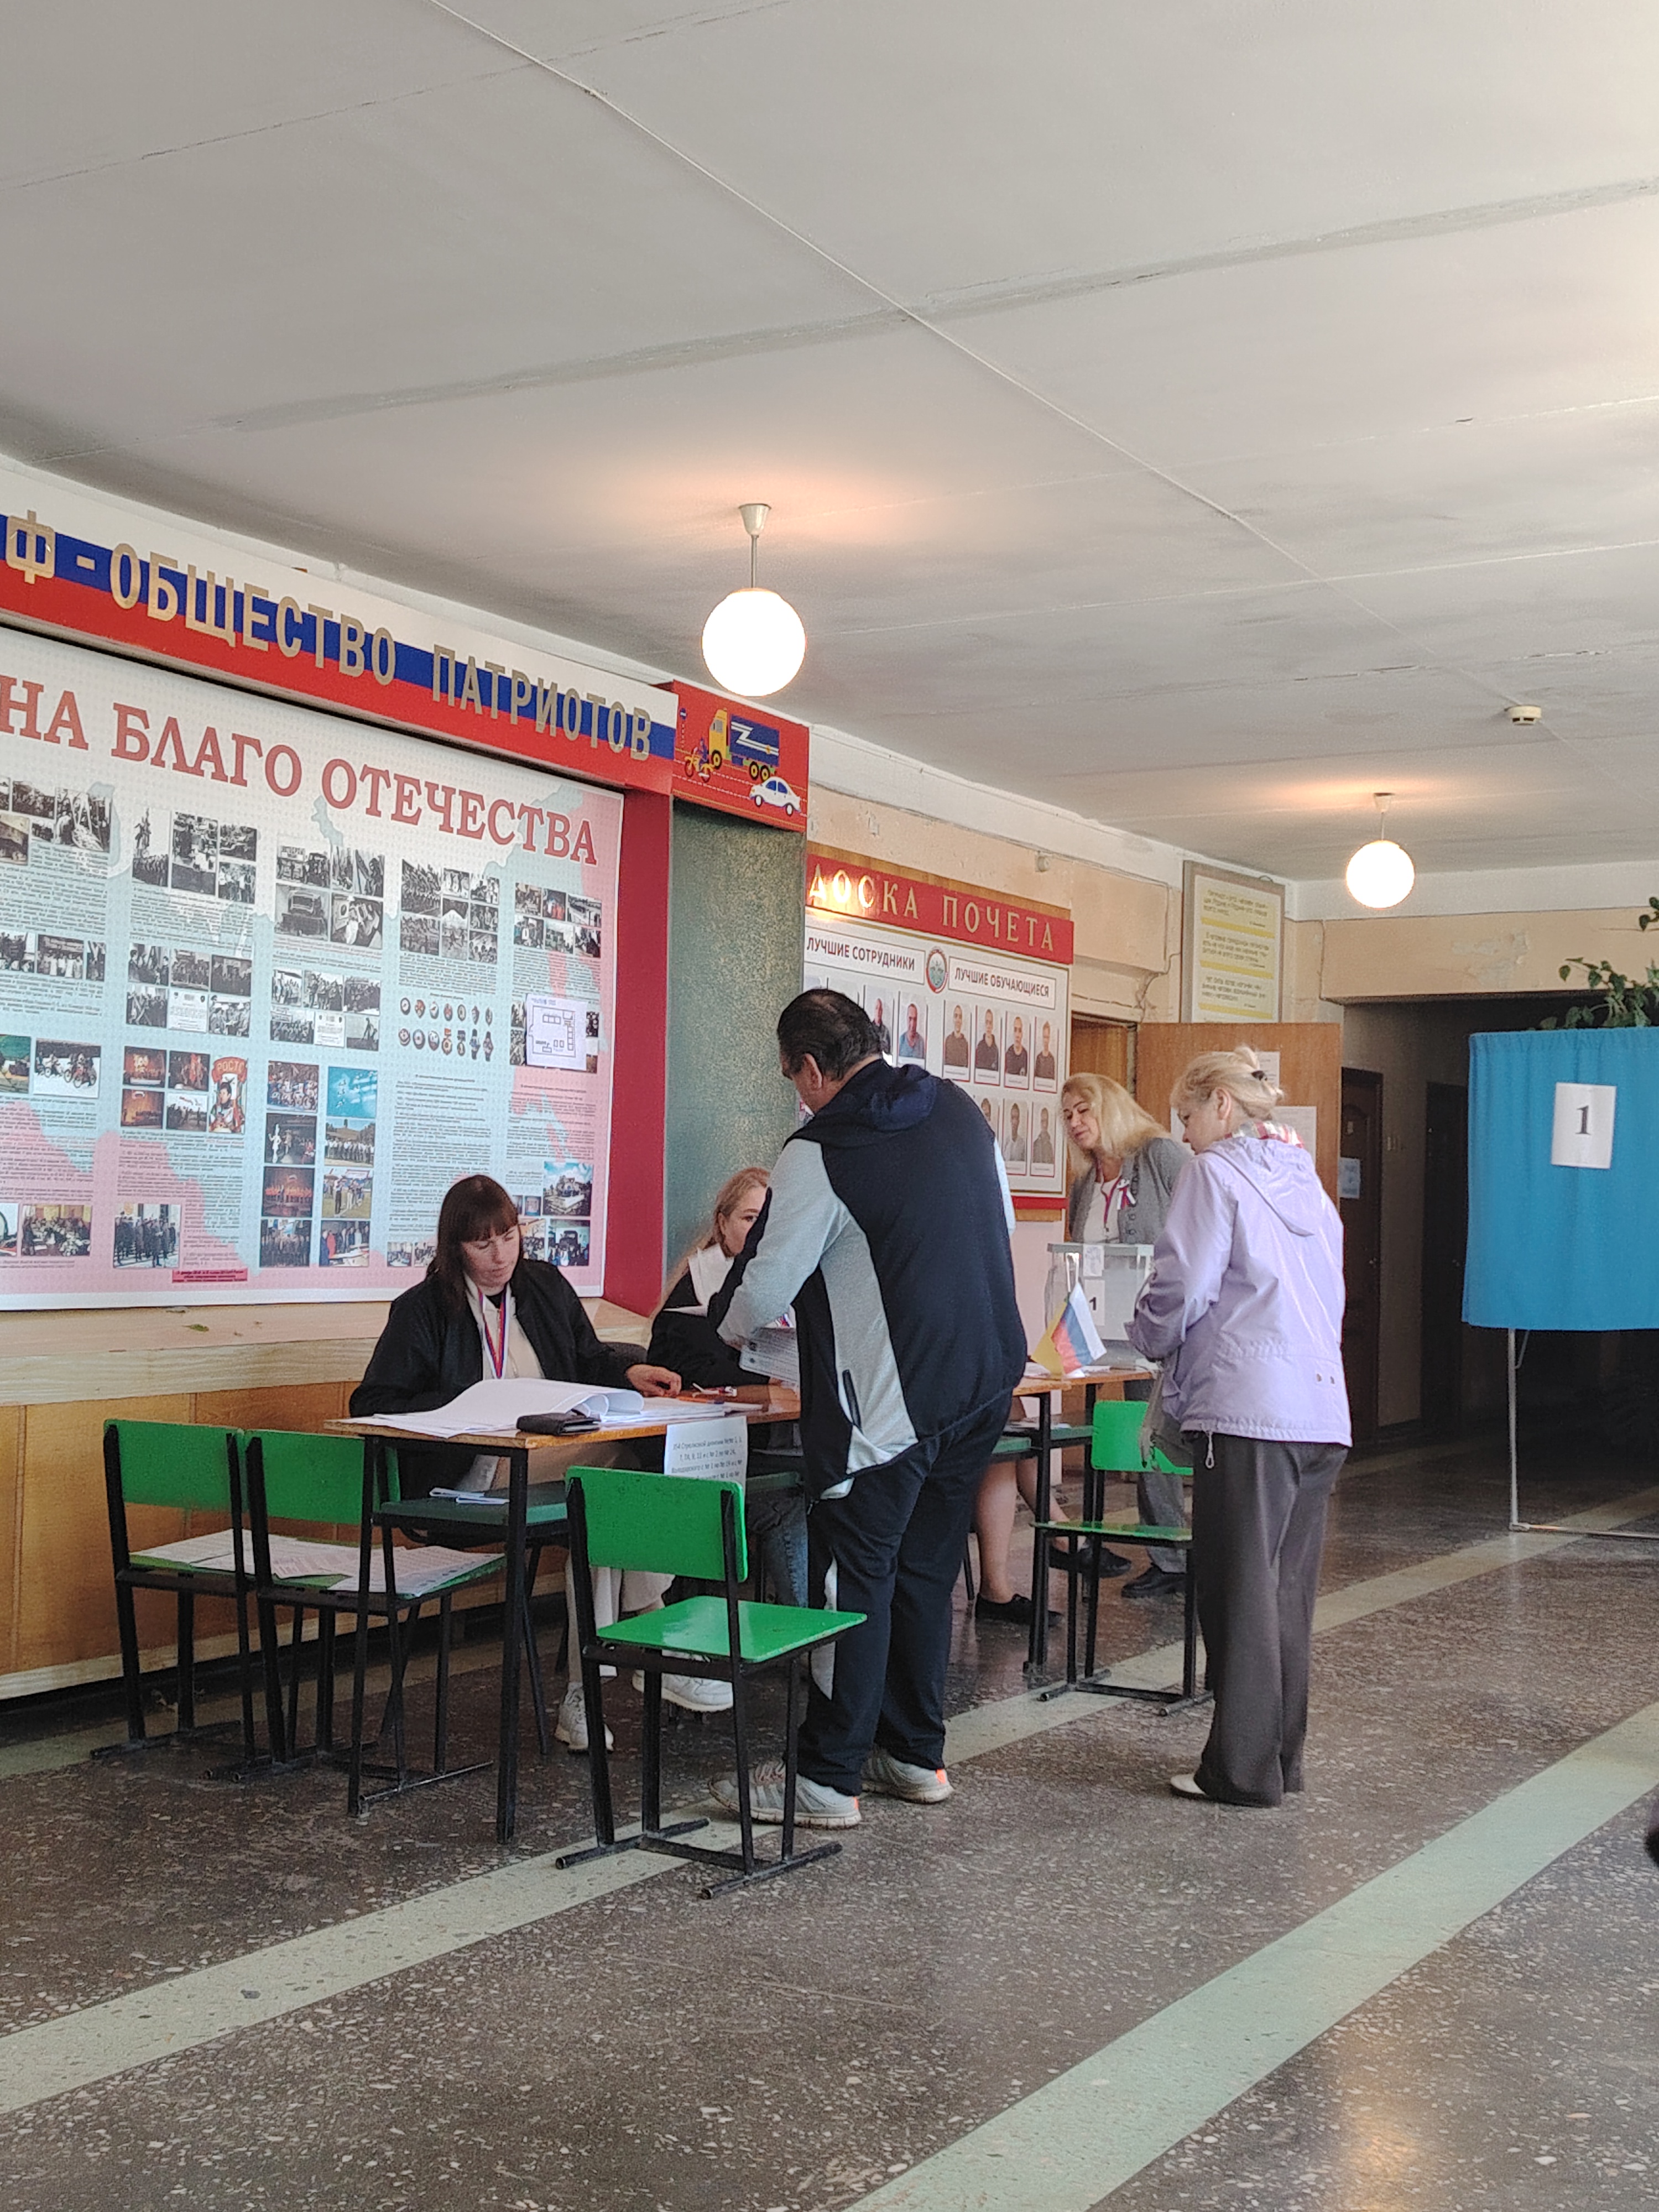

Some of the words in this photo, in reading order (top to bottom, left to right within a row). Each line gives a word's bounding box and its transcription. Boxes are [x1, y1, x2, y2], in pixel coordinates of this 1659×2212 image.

[110, 542, 397, 686] ОБЩЕСТВО
[431, 643, 651, 761] ПАТРИОТОВ
[0, 675, 89, 750] НА
[111, 702, 302, 797] БЛАГО
[321, 758, 597, 866] ОТЕЧЕСТВА
[807, 863, 919, 920] ДОСКА
[942, 894, 1054, 952] ПОЧЕТА
[806, 937, 850, 958] ЛУЧШИЕ
[852, 946, 915, 972] СОТРУДНИКИ
[954, 967, 989, 985] ЛУЧШИЕ
[990, 975, 1050, 997] ОБУЧАЮЩИЕСЯ
[1574, 1104, 1592, 1135] 1
[1089, 1296, 1097, 1311] 1
